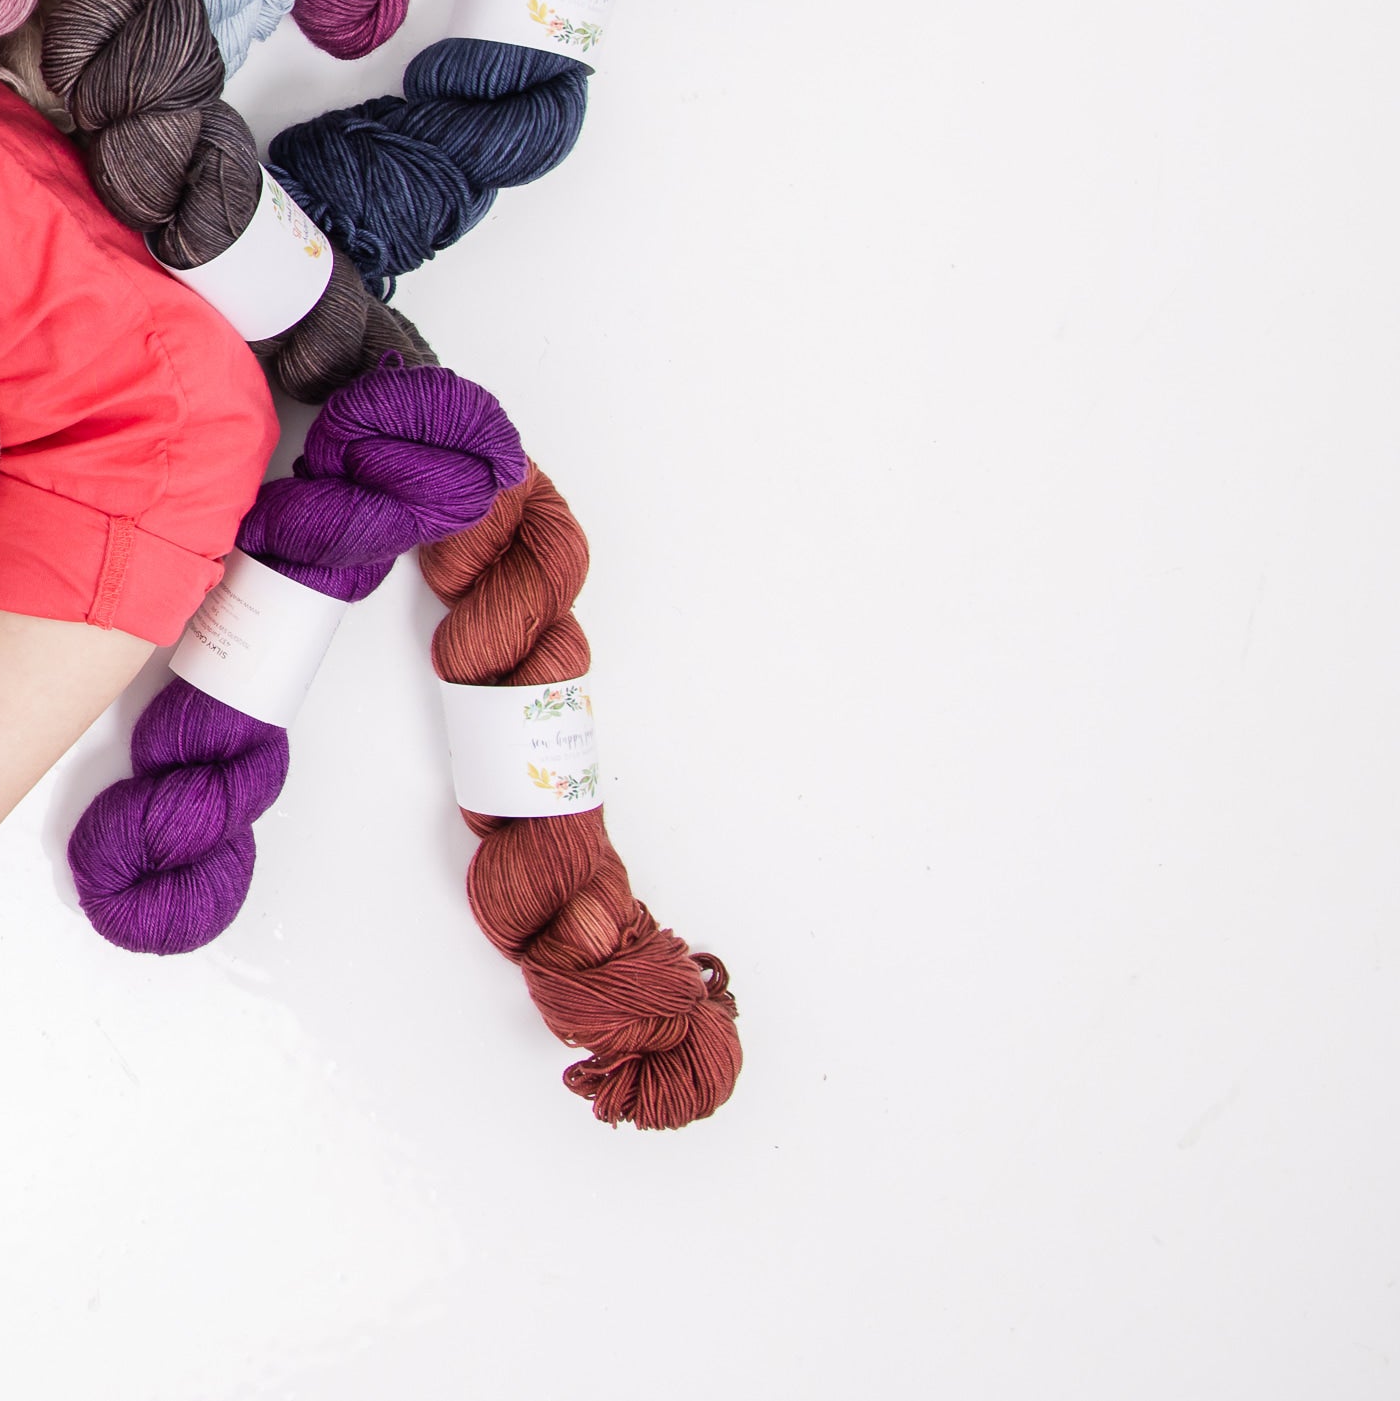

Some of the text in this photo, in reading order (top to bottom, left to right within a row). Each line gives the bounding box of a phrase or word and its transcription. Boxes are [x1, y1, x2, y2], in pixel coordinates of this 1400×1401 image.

[205, 641, 228, 659] SILKY
[531, 738, 548, 749] sew
[556, 730, 584, 750] happy
